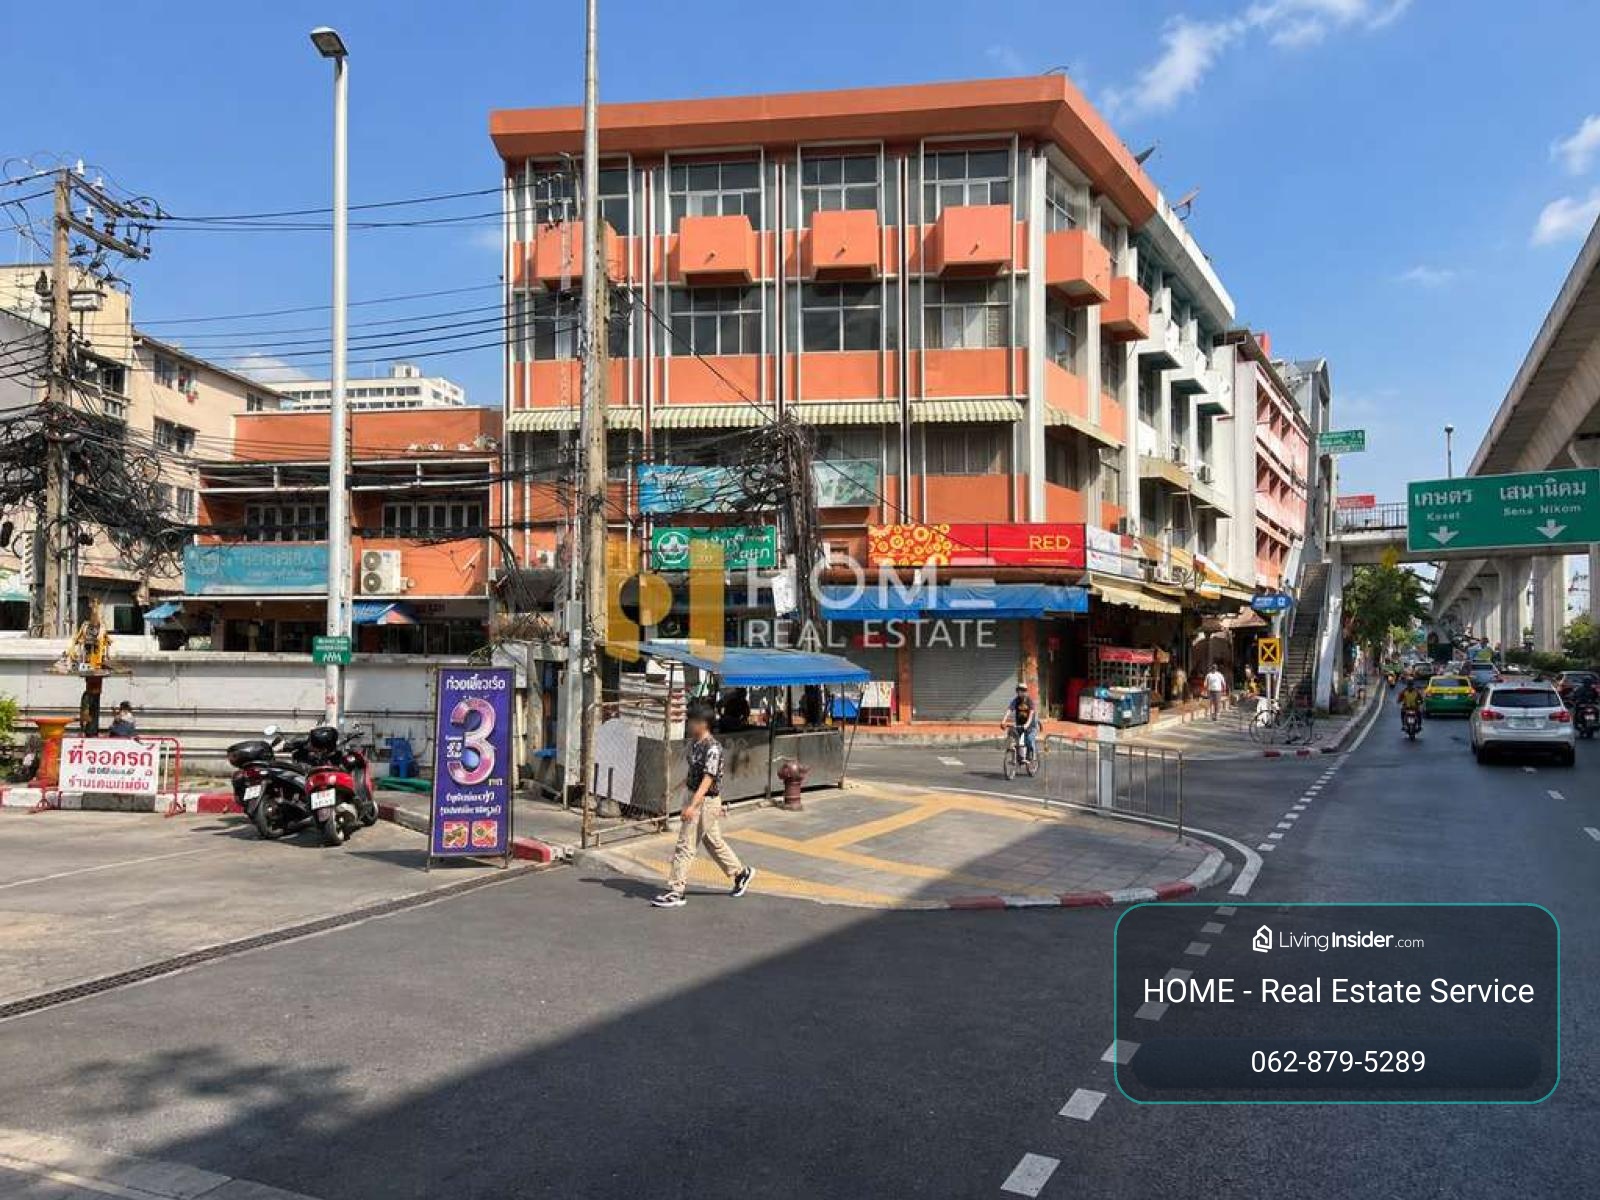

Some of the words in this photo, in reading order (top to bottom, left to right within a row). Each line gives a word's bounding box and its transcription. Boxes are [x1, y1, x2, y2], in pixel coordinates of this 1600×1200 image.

[1414, 489, 1473, 507] เกษตร
[1500, 477, 1587, 500] เสนานิคม
[1028, 535, 1071, 551] RED
[450, 698, 497, 786] 3
